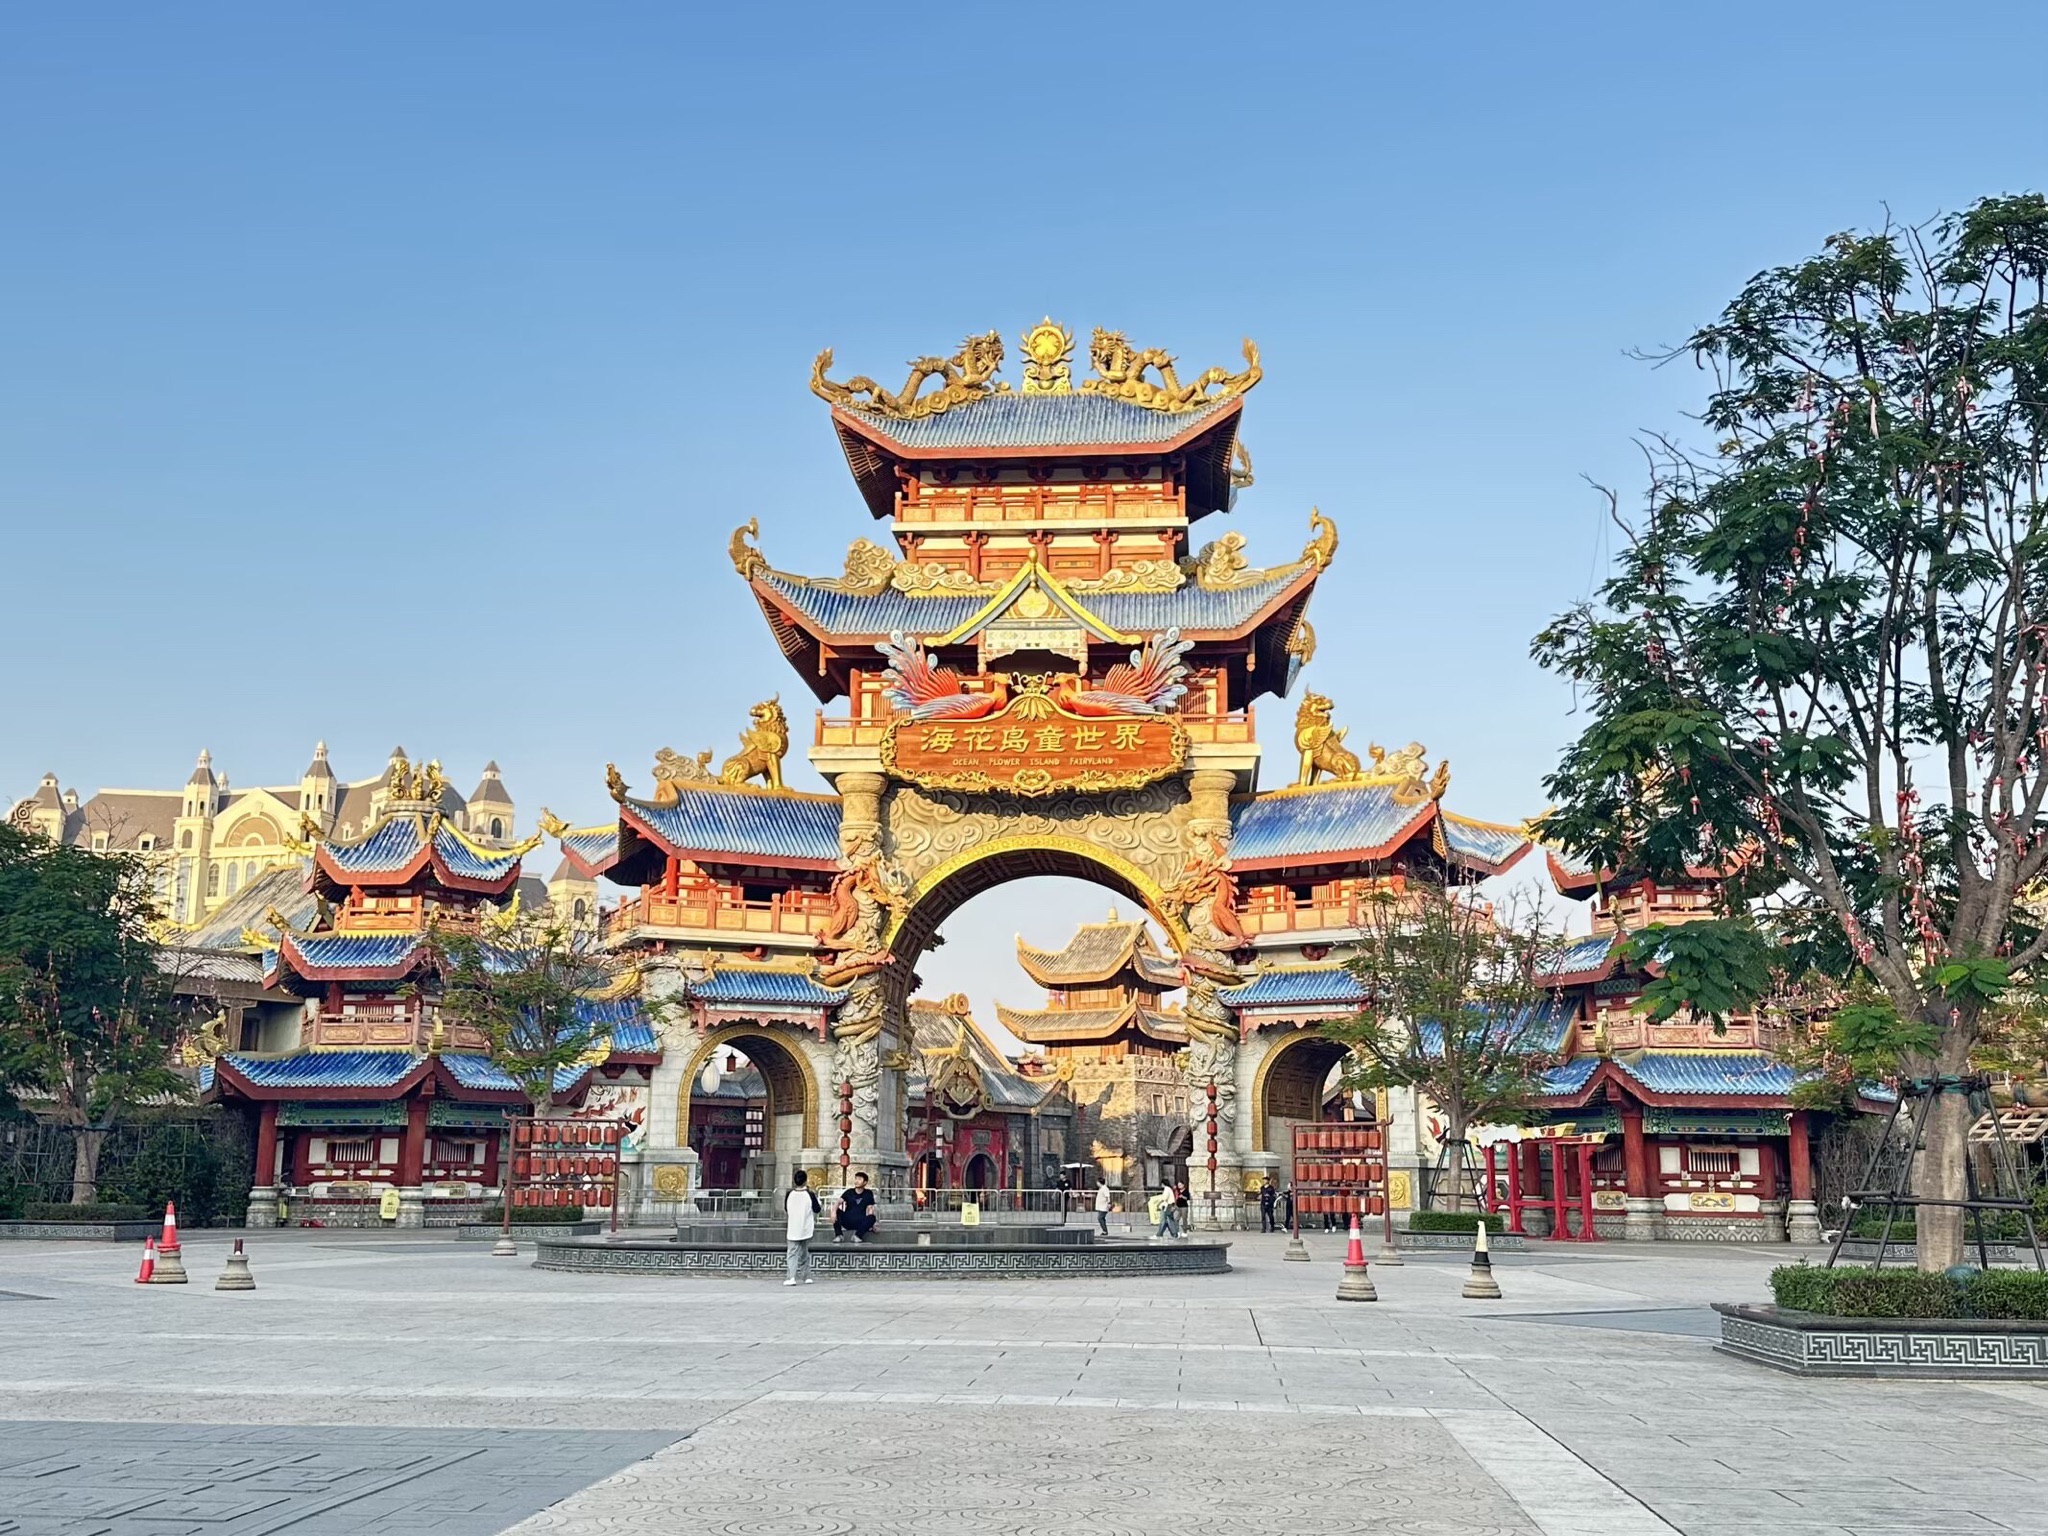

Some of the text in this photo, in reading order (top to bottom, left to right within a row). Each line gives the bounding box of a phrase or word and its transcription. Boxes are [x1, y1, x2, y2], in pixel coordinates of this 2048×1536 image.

[920, 724, 1148, 753] 海花岛童世界
[952, 757, 1115, 766] OCEAN FLOWER ISLAND FAIRYLAND
